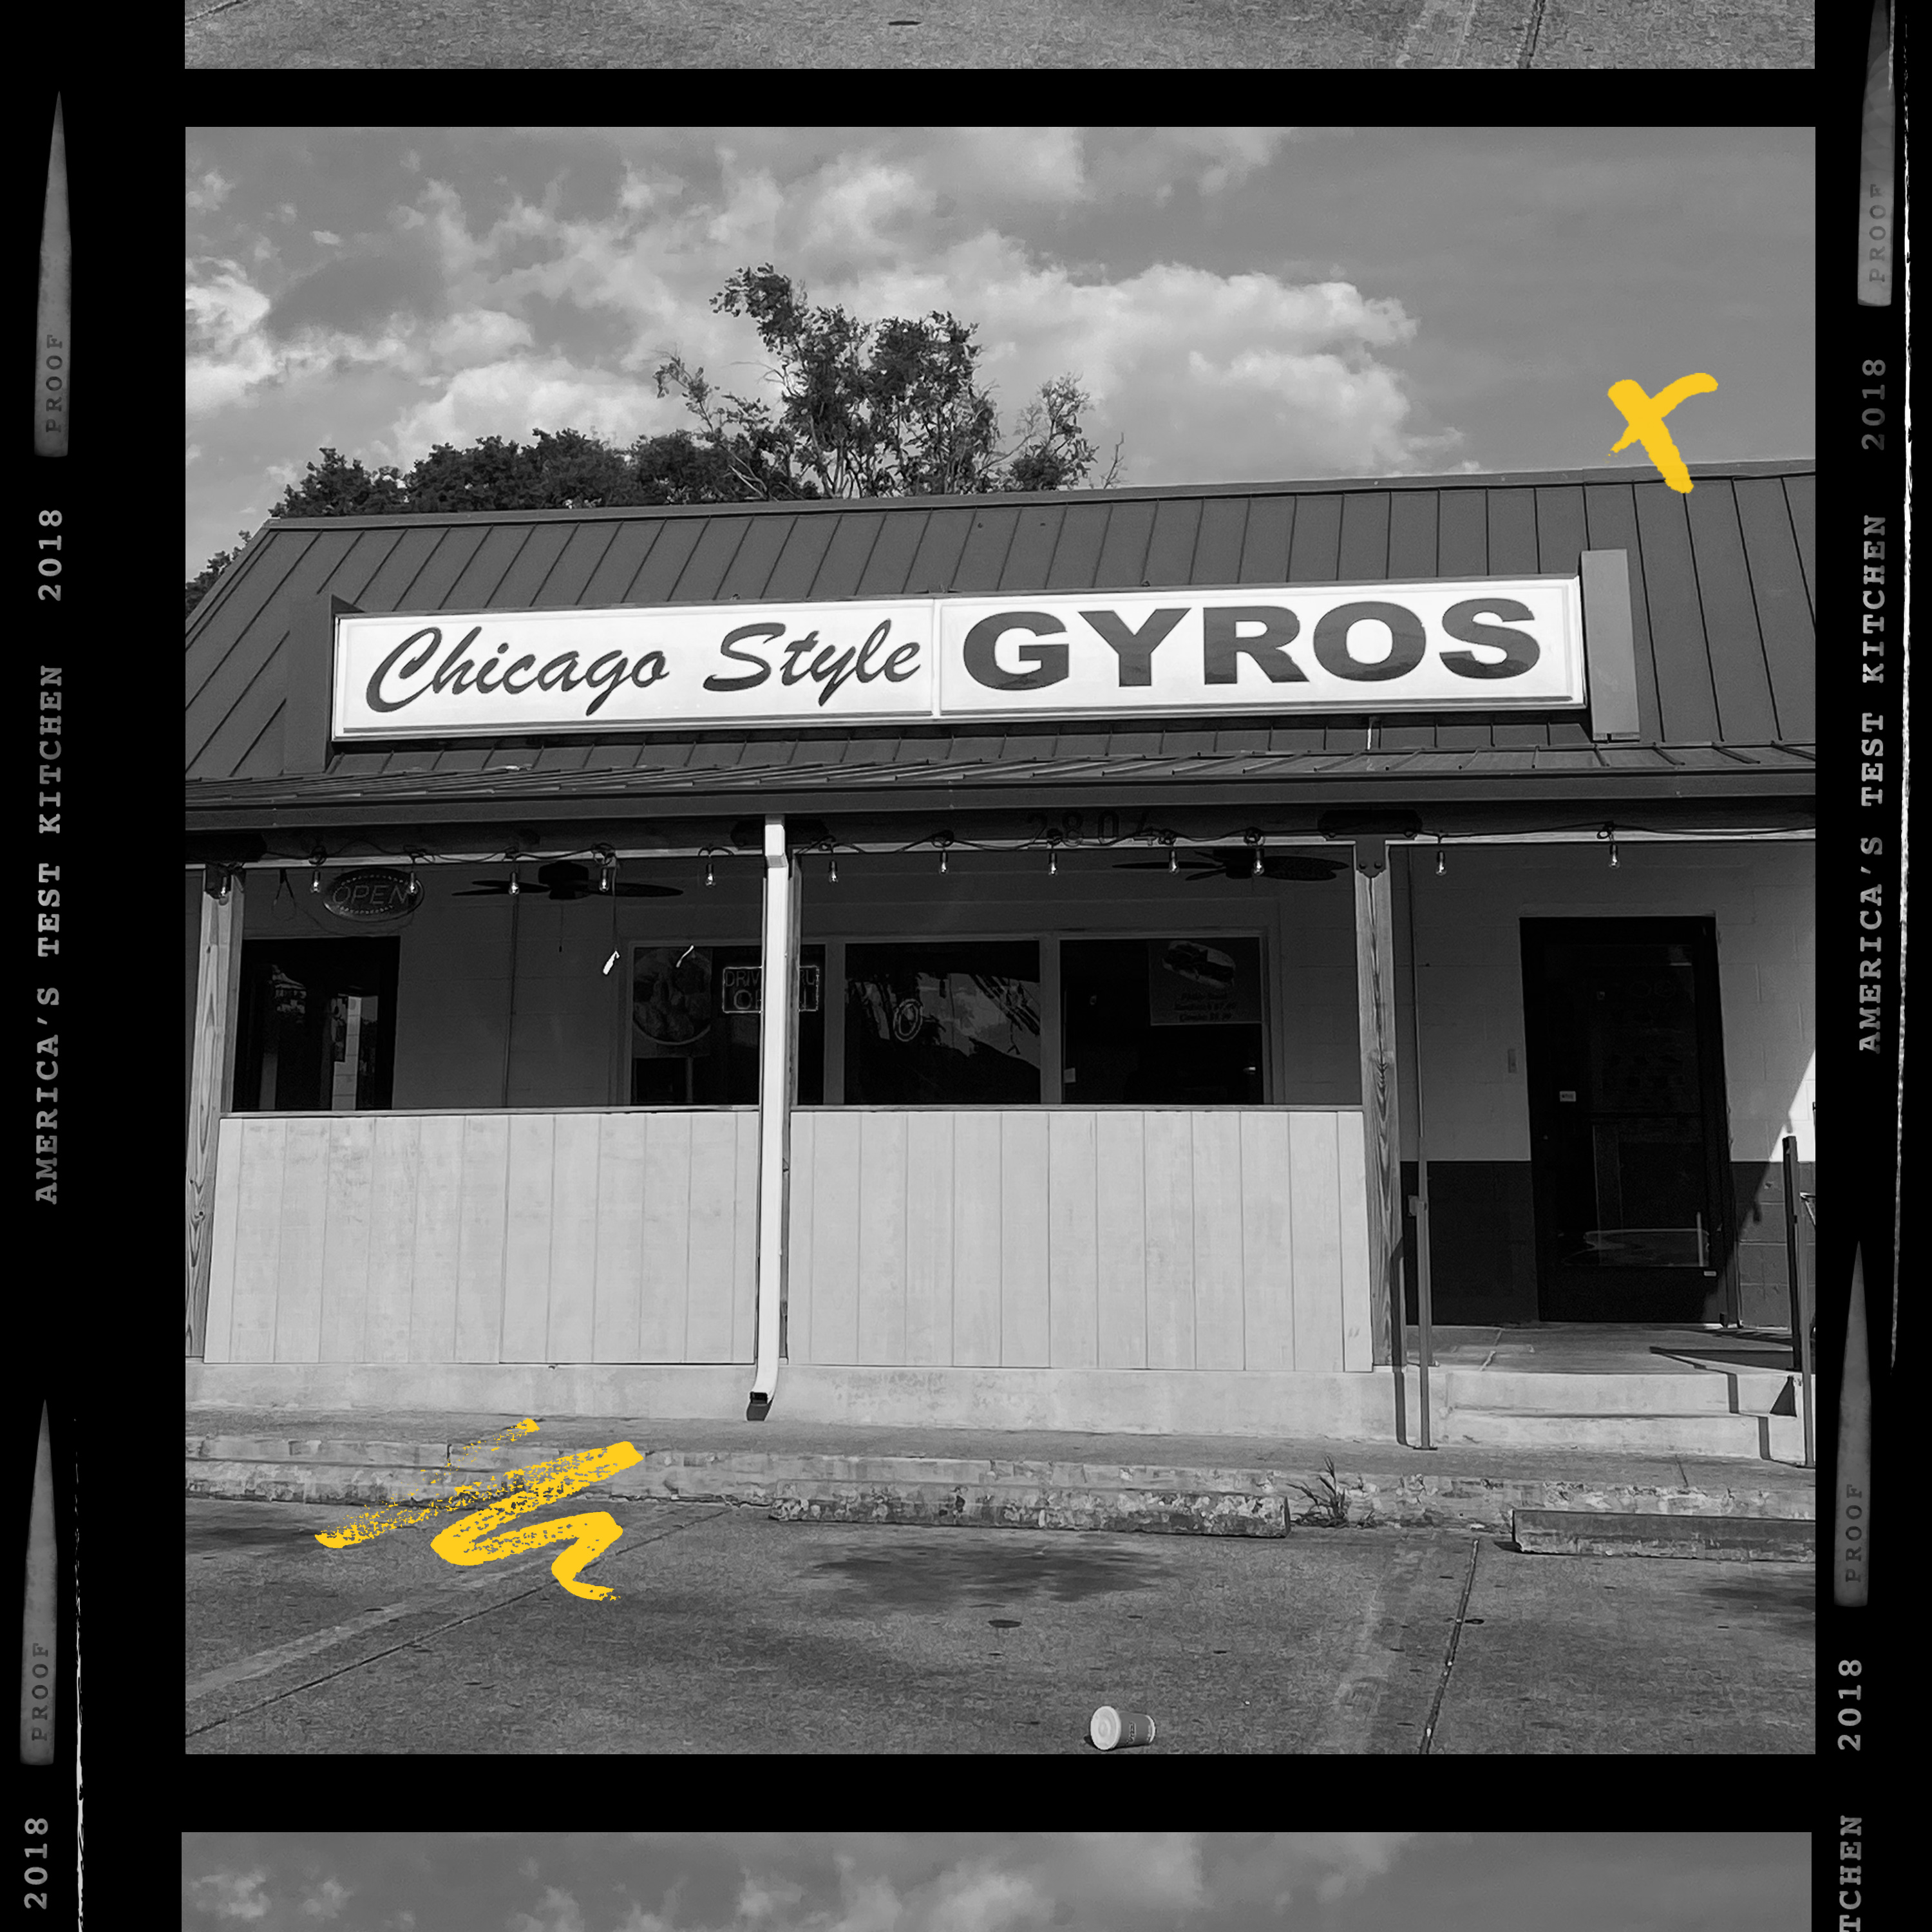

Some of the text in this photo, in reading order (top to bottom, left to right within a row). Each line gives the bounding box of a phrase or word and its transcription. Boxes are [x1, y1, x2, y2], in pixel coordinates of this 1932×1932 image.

[365, 598, 1541, 717] Chicago Style GYROS
[332, 885, 408, 904] OPEN
[726, 971, 761, 987] DRIV
